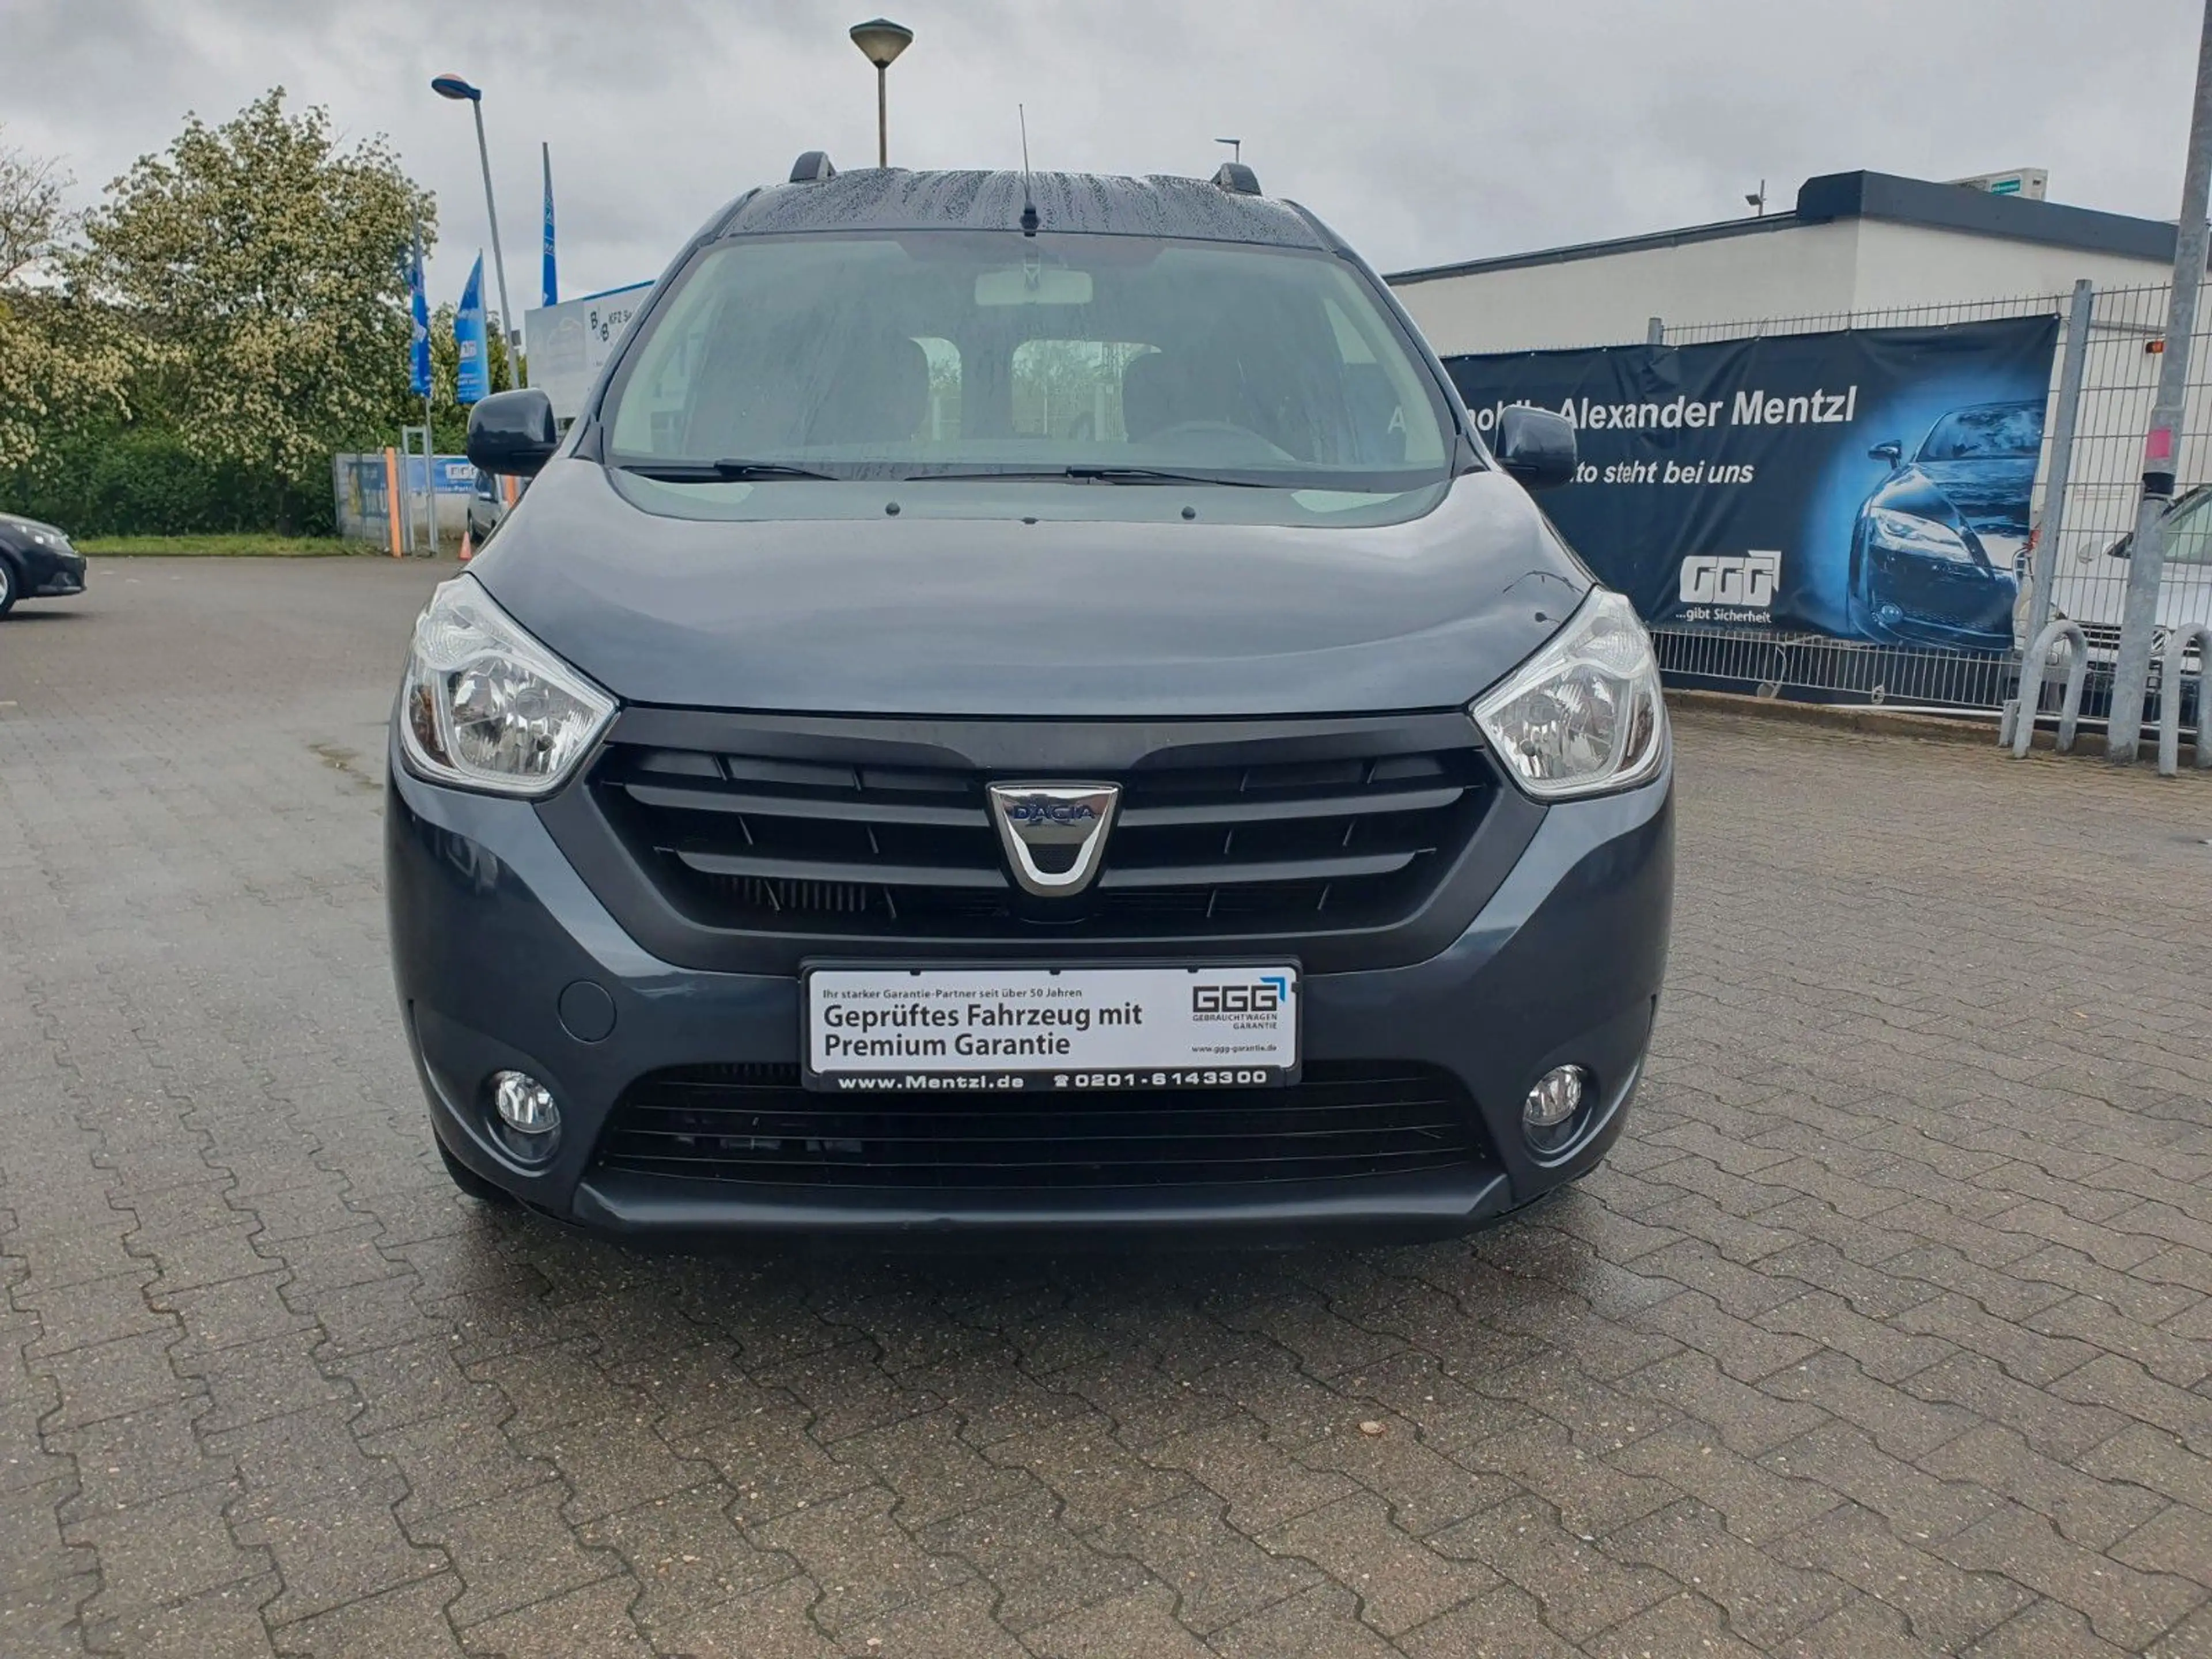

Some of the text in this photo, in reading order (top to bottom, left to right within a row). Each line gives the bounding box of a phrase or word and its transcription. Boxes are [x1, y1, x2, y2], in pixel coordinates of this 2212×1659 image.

[1559, 395, 1723, 430] Alexander
[1731, 385, 1857, 426] Mentzl
[1603, 460, 1657, 483] steht
[1663, 460, 1705, 483] bei
[1707, 464, 1755, 483] uns
[1714, 608, 1772, 623] Sicherheit
[1012, 805, 1095, 822] DACIA
[823, 987, 1082, 999] Ihr starker Garantie-Partner seit über 50 Jahren
[1193, 986, 1277, 1012] GGG
[824, 1002, 1142, 1033] Geprüftes Fahrzeug mit
[1192, 1013, 1277, 1021] GEBRAUCHTWAGEN
[1233, 1022, 1277, 1030] GARANTIE
[825, 1032, 1071, 1056] Premium Garantie
[1191, 1044, 1277, 1054] www.ggg-garantie.de
